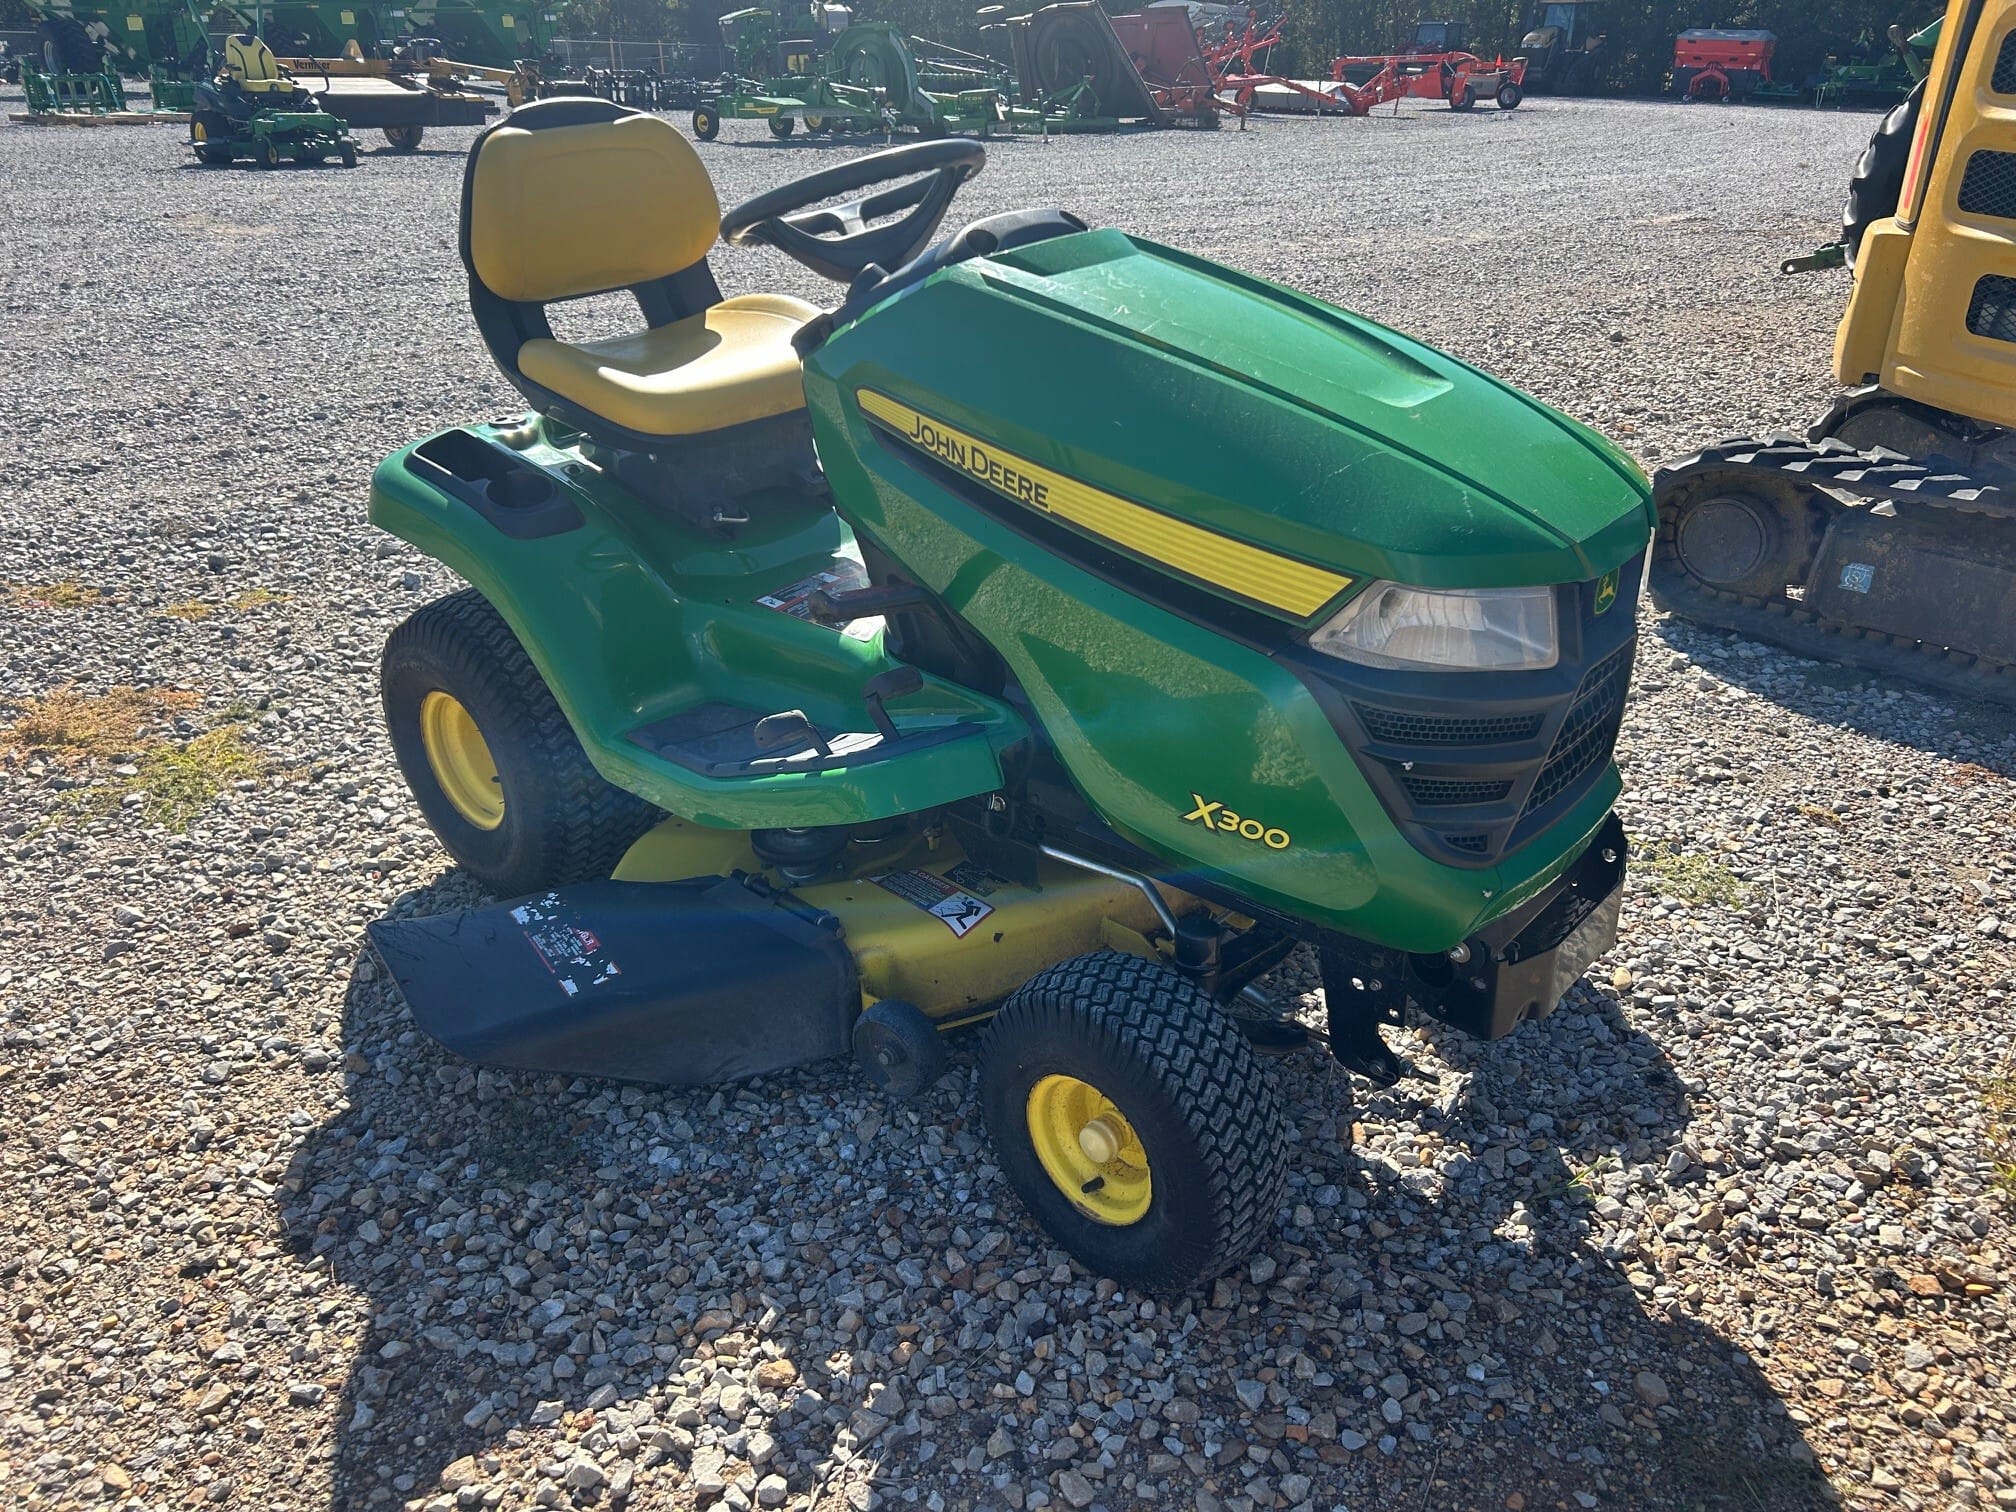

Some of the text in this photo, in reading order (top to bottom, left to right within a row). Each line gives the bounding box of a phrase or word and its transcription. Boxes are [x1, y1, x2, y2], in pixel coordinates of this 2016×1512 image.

[910, 416, 1048, 508] JOHN DEERE
[1183, 793, 1290, 849] X300
